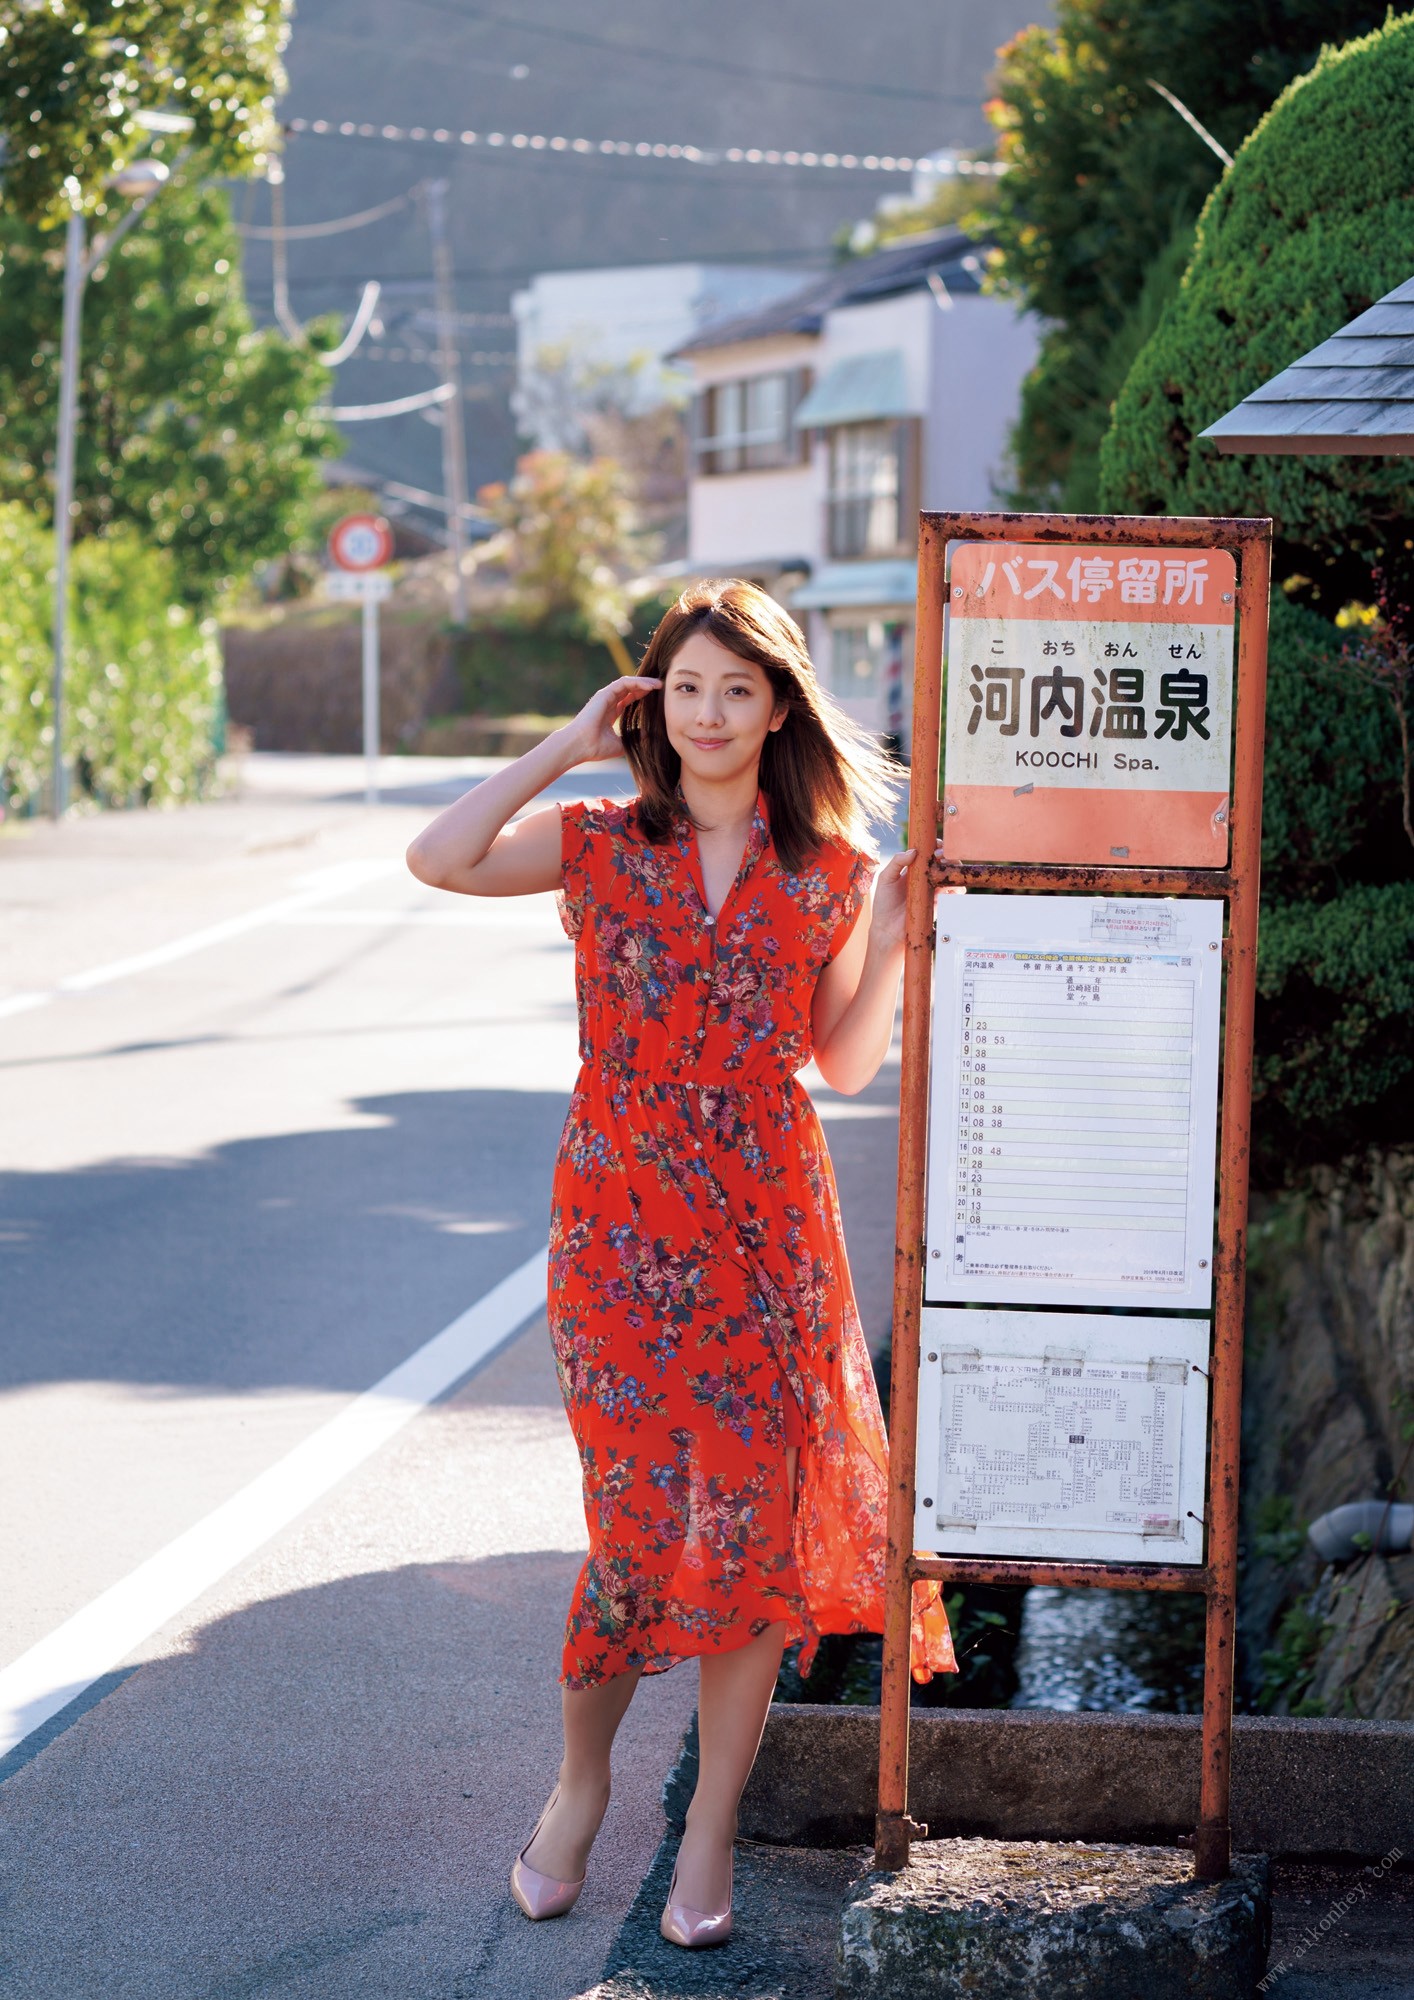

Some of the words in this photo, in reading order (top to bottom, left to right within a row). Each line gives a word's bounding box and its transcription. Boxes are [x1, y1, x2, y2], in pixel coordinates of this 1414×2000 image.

[981, 556, 1209, 605] バス停留所
[991, 640, 1004, 654] こ
[1042, 640, 1075, 656] おち
[1104, 642, 1138, 657] おん
[1168, 644, 1201, 660] せん
[967, 664, 1210, 741] 河内温泉
[1015, 751, 1098, 770] KOOCHI
[1114, 754, 1160, 771] Spa.
[1067, 984, 1100, 993] 松崎経由
[965, 1004, 971, 1013] 6
[965, 1017, 970, 1027] 7
[976, 1022, 987, 1030] 23
[964, 1031, 970, 1041] 8
[976, 1036, 987, 1044] 08
[994, 1036, 1005, 1044] 53
[964, 1045, 969, 1055] 9
[975, 1063, 986, 1071] 08
[974, 1077, 985, 1085] 08
[974, 1091, 985, 1099] 08
[974, 1105, 984, 1113] 08
[992, 1105, 1002, 1114] 38
[973, 1119, 984, 1127] 08
[992, 1119, 1002, 1128] 38
[972, 1132, 984, 1141] 08
[972, 1146, 983, 1155] 08
[990, 1147, 1001, 1155] 48
[972, 1160, 983, 1168] 28
[971, 1174, 982, 1182] 23
[972, 1188, 982, 1196] 18
[971, 1202, 981, 1210] 13
[970, 1216, 980, 1224] 08
[1051, 1367, 1082, 1378] 路線図
